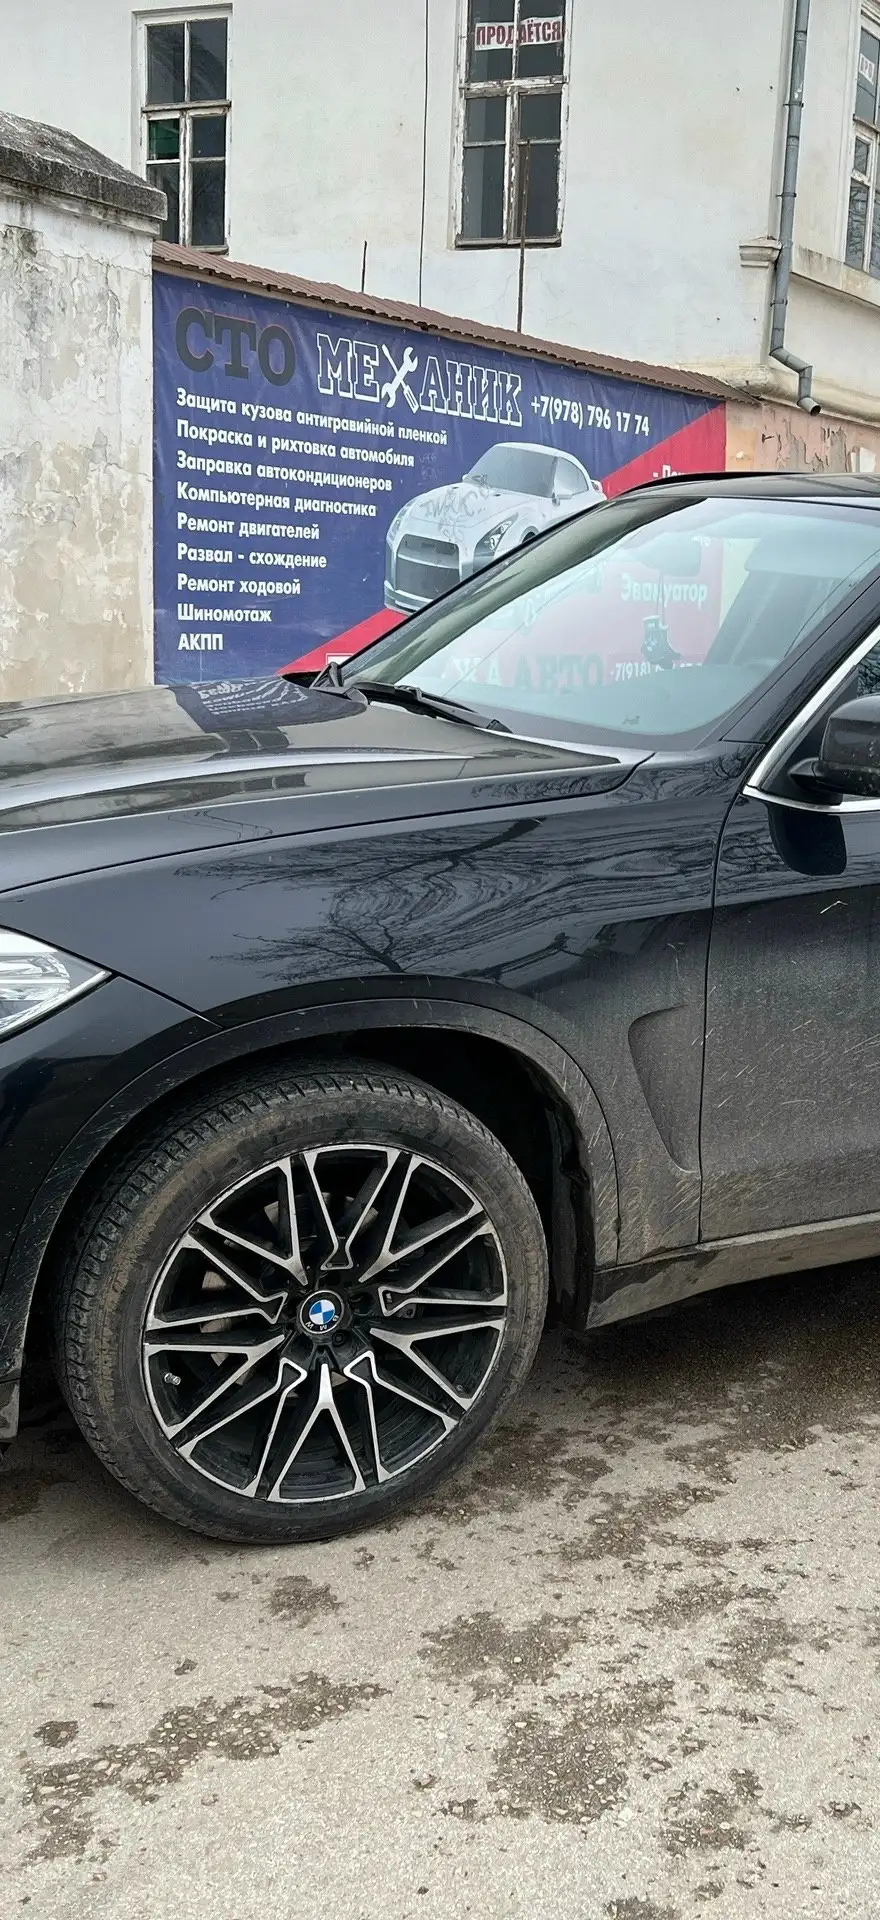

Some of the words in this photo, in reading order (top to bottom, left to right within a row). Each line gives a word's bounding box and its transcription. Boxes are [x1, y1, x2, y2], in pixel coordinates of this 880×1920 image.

[476, 19, 561, 46] ПРОДАЁТСЯ
[175, 306, 296, 387] СТО
[531, 395, 584, 430] +7(978)
[587, 405, 612, 430] 796
[616, 411, 631, 434] 17
[634, 414, 650, 436] 74
[176, 387, 236, 415] Защита
[241, 403, 292, 424] кузова
[296, 410, 395, 439] антигравийной
[398, 426, 448, 446] пленкой
[176, 418, 253, 450] Покраска
[257, 434, 267, 448] и
[271, 436, 336, 458] рихтовка
[339, 446, 415, 467] автомобиля
[176, 449, 252, 478] Заправка
[256, 464, 393, 493] автокондиционеров
[176, 481, 290, 512] Компьютерная
[294, 498, 377, 517] диагностика
[176, 511, 235, 534] Ремонт
[238, 519, 320, 541] двигателей
[176, 542, 233, 564] Развал
[248, 550, 327, 569] схождение
[176, 572, 235, 594] Ремонт
[239, 577, 301, 597] ходовой
[176, 603, 272, 623] Шиномотаж
[177, 633, 224, 651] АКПП
